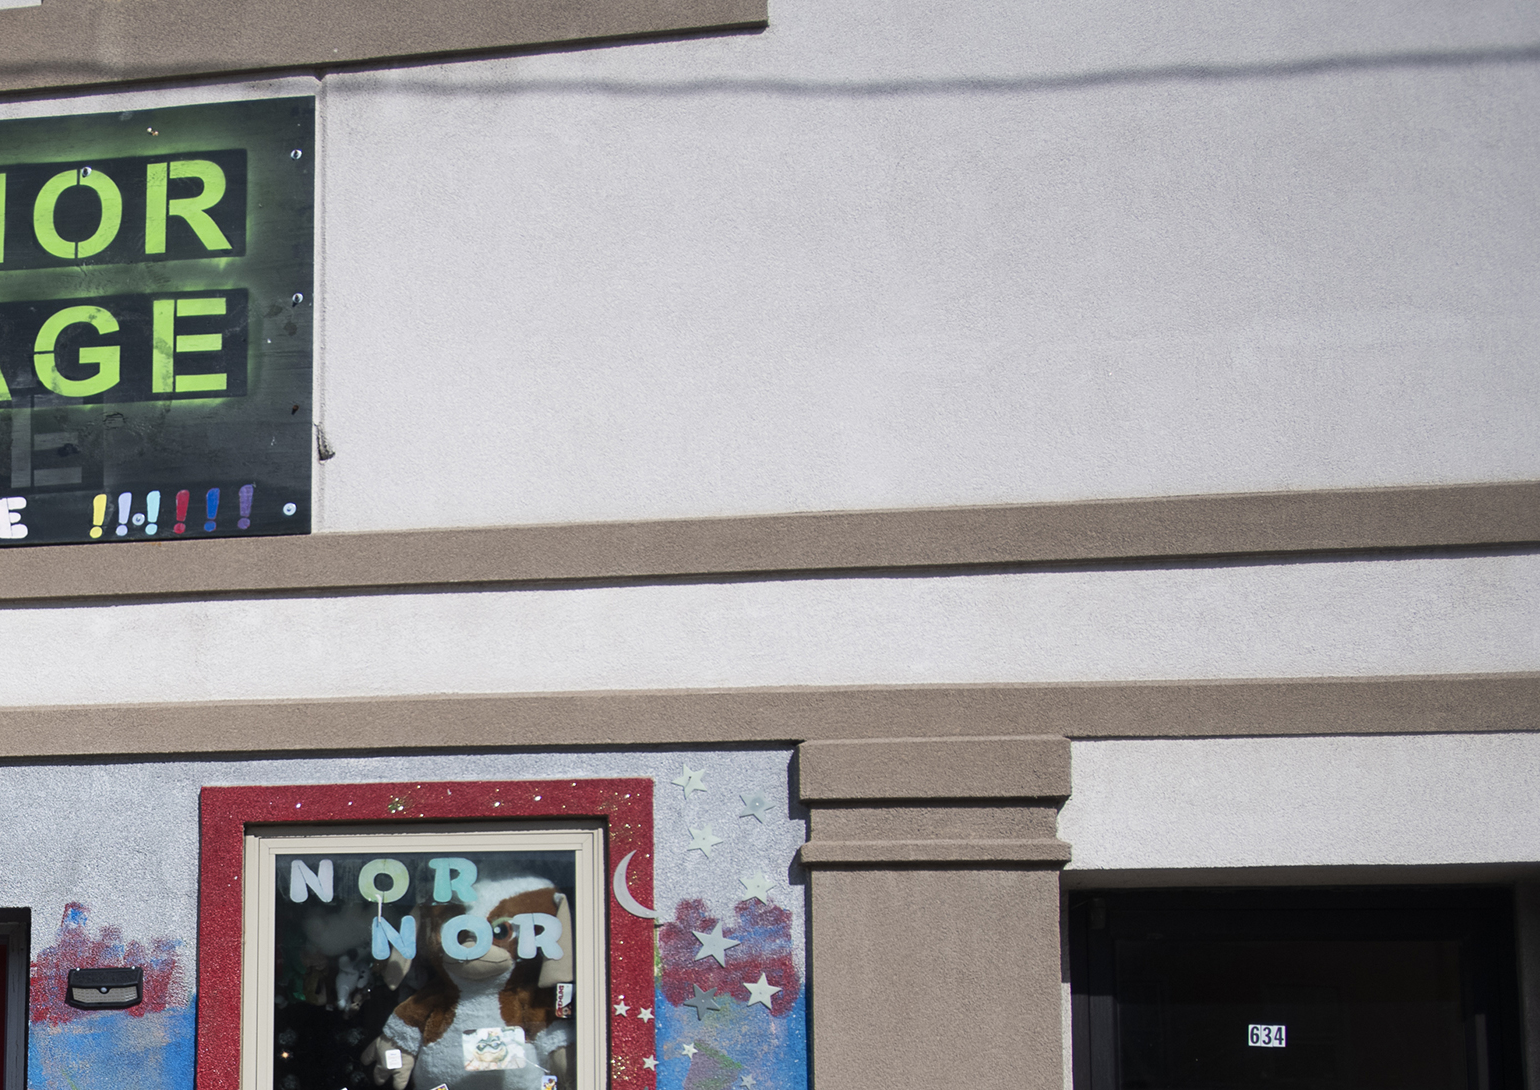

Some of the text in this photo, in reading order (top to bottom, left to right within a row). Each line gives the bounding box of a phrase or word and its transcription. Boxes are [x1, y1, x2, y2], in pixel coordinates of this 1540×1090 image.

[289, 857, 479, 904] NOR
[371, 912, 565, 961] NOR
[1249, 1026, 1285, 1045] 634
